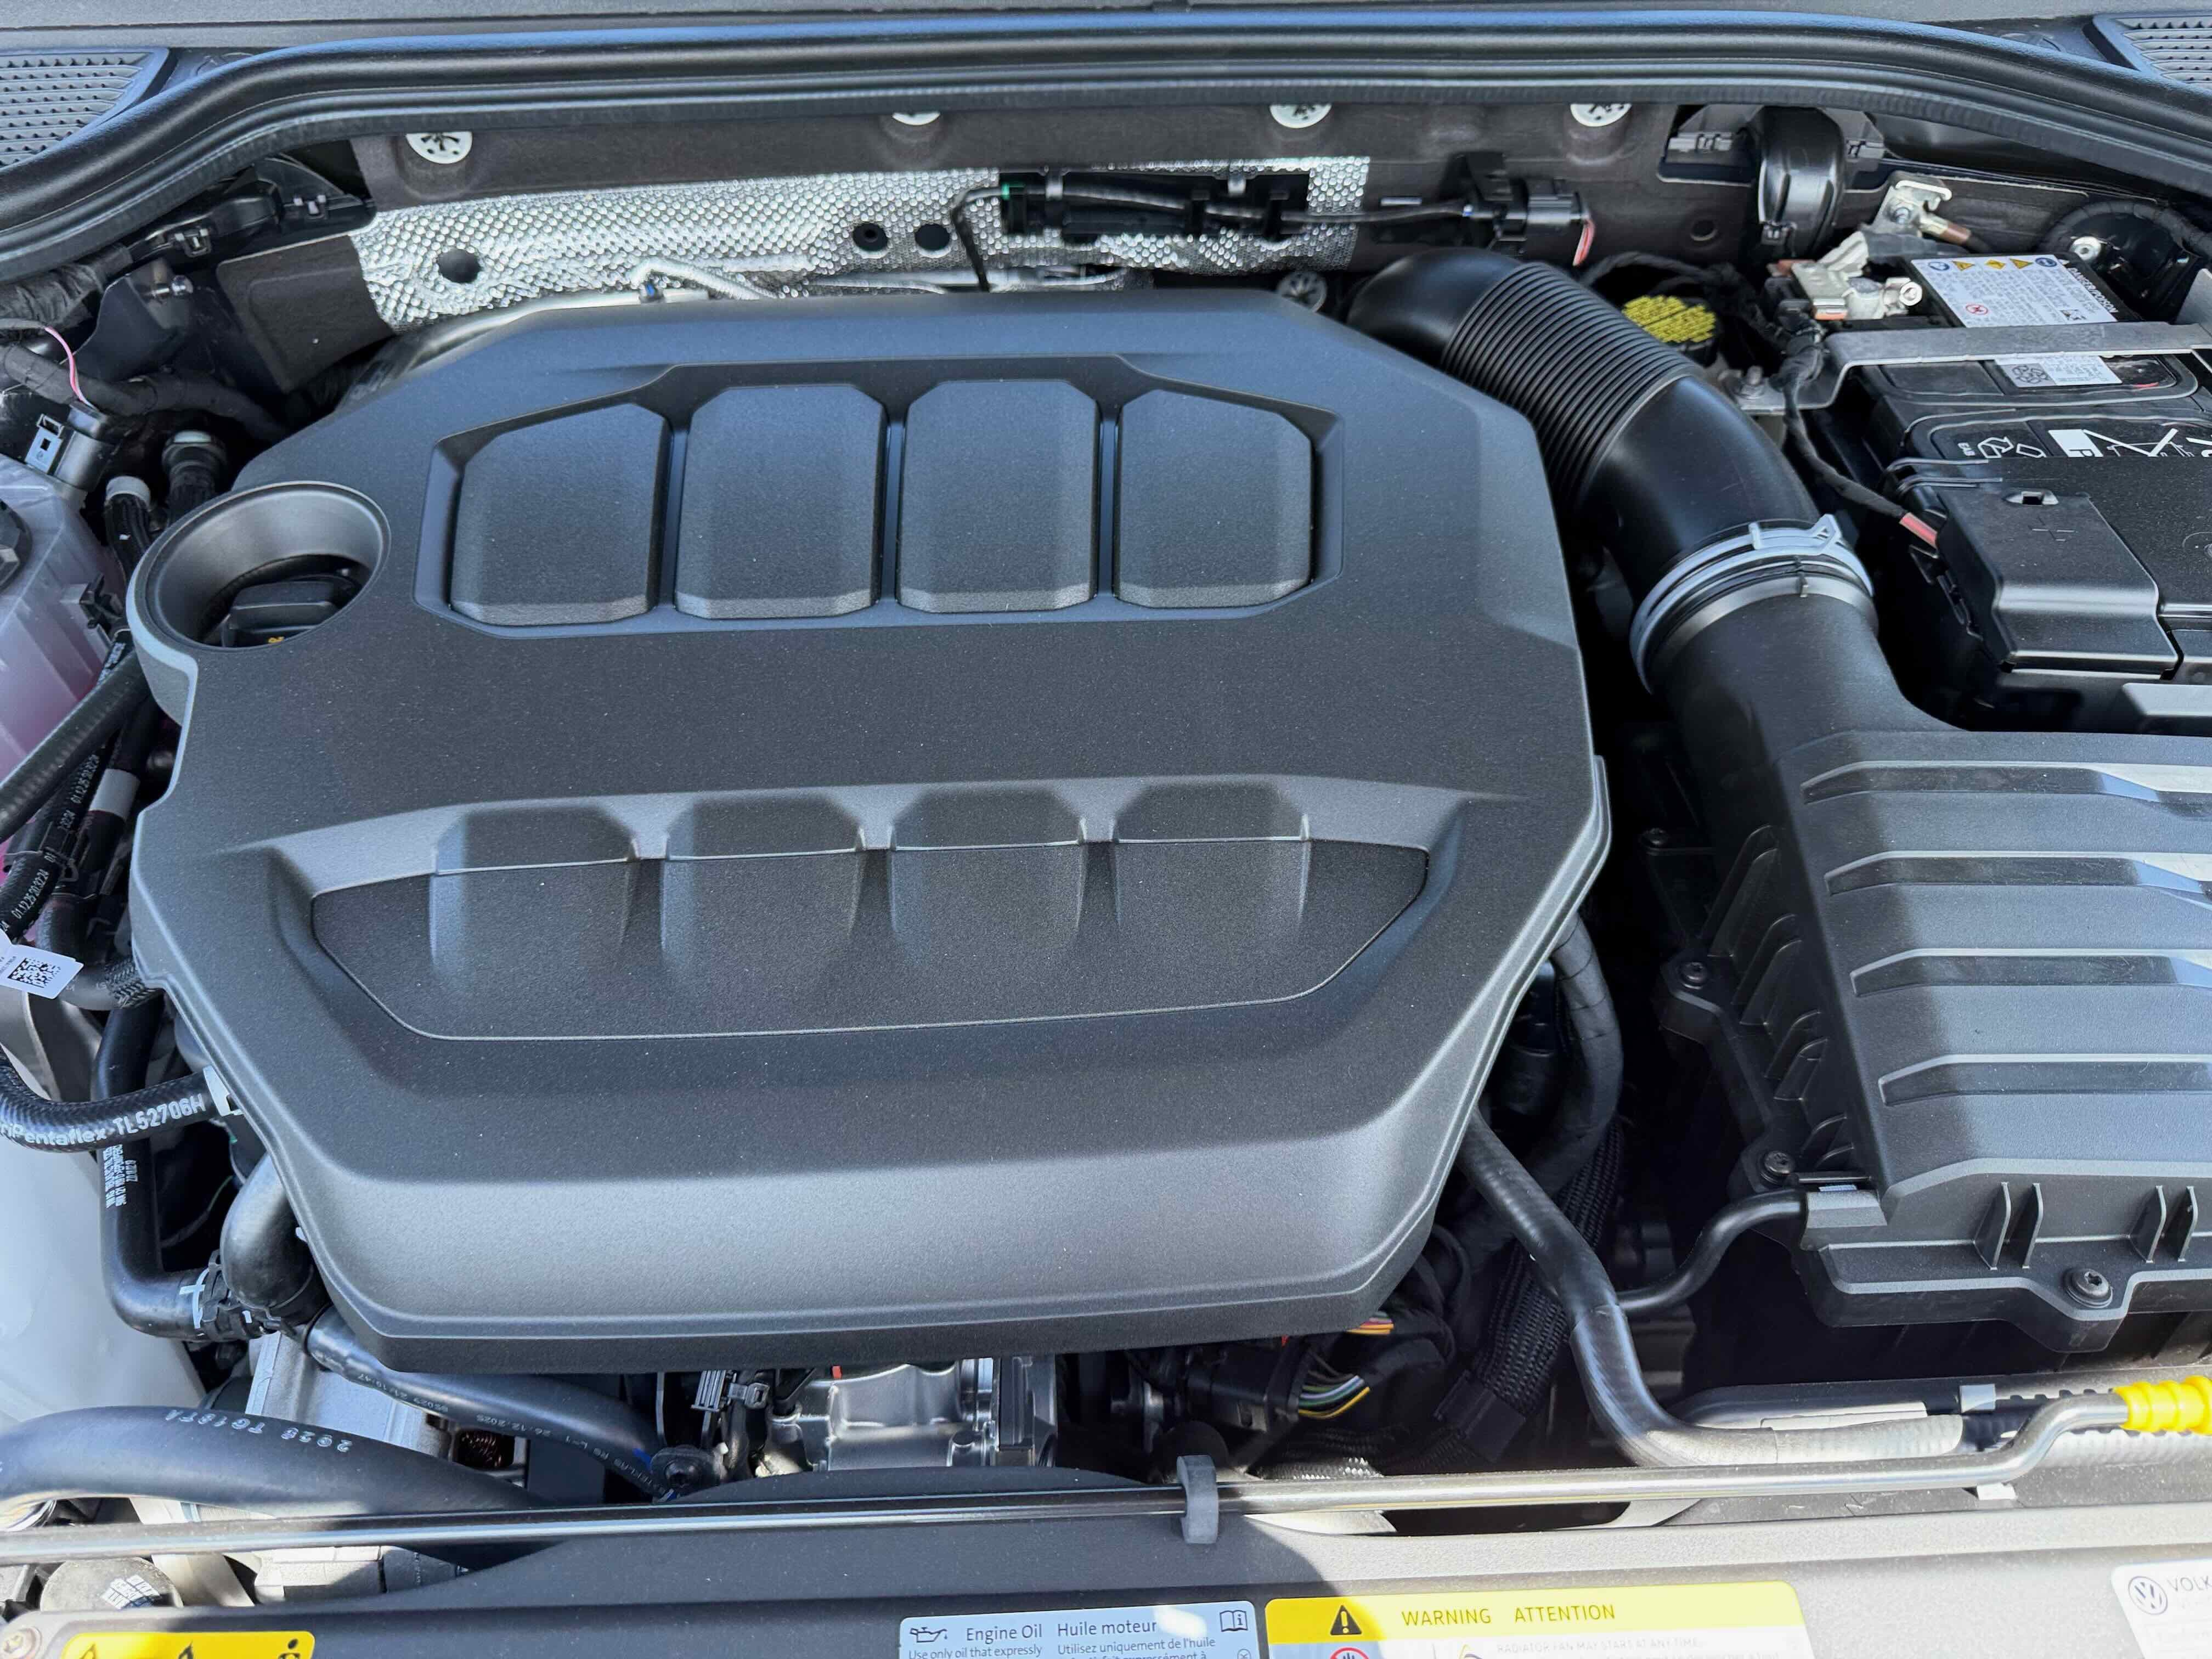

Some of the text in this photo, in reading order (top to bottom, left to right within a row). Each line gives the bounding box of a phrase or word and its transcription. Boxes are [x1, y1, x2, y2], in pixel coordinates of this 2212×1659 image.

[1401, 1604, 1616, 1627] WARNING ATTENTION
[967, 1624, 1042, 1644] Engine Oil
[1058, 1620, 1157, 1637] Huile moteur
[909, 1644, 1043, 1659] Use only oil that expressly
[1058, 1637, 1216, 1655] Utilisez uniquement de l'huile
